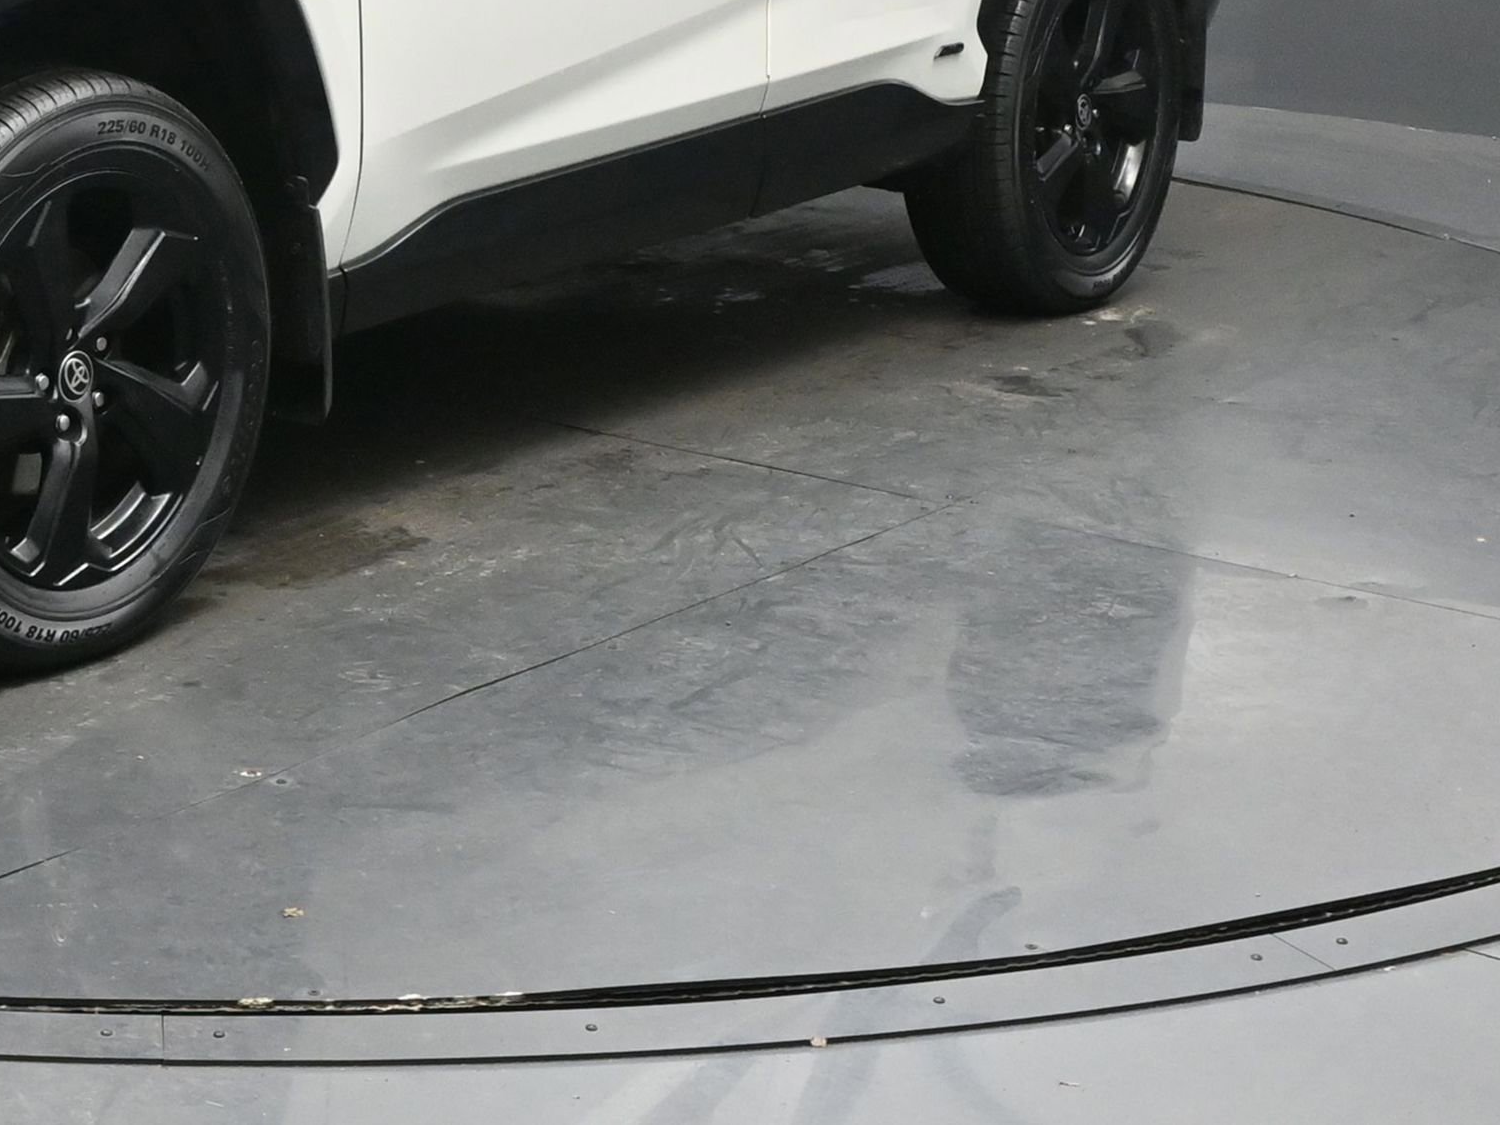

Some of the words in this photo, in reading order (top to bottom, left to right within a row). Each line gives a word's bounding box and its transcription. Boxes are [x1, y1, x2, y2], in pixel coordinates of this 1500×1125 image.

[97, 119, 146, 135] 225/60
[150, 124, 177, 145] R18
[26, 624, 54, 642] R18
